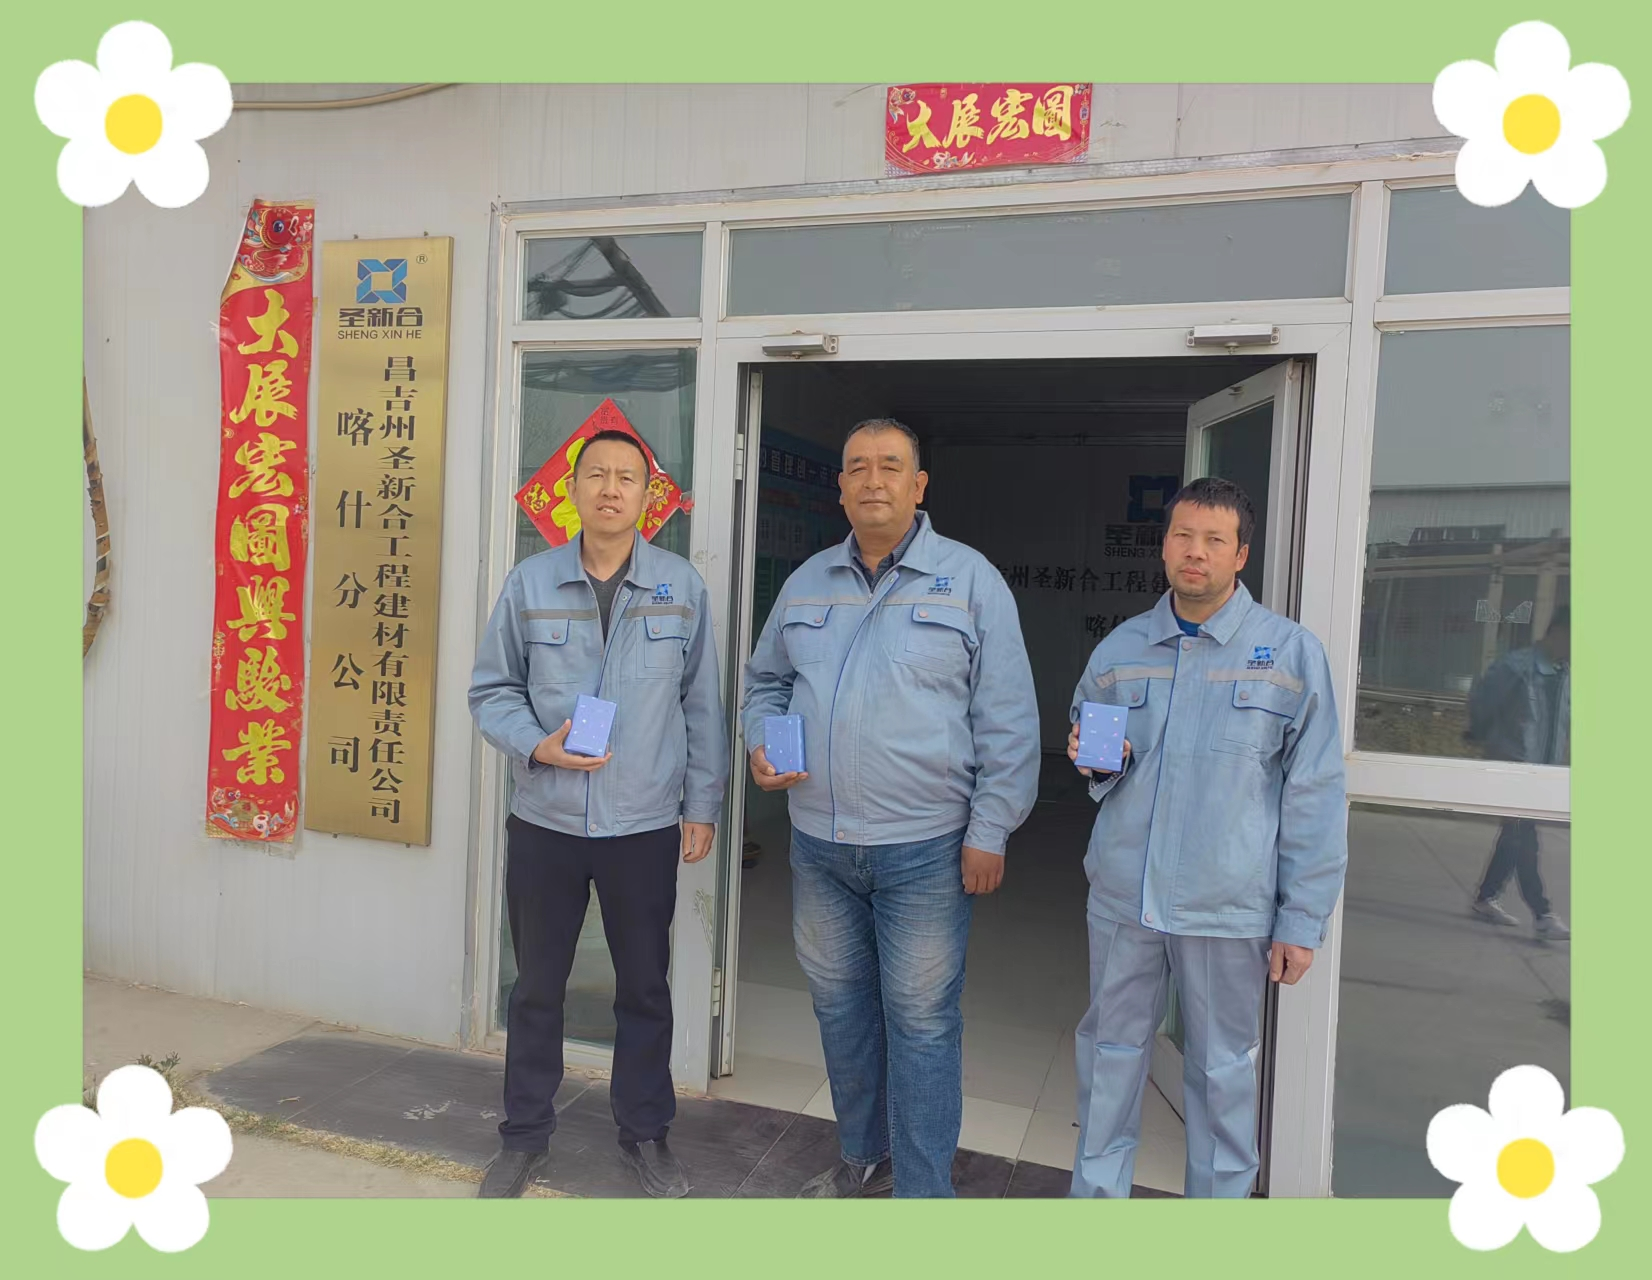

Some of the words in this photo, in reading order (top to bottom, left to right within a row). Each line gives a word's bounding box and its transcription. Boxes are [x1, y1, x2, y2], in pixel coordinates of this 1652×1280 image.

[337, 307, 424, 328] 圣新合
[337, 329, 379, 340] SHENG
[381, 329, 403, 340] XIN
[406, 329, 422, 340] HE
[1104, 546, 1146, 558] SHENG
[328, 407, 374, 774] 喀什分公司
[368, 355, 418, 824] 昌吉州圣新合工程建材有限责任公司
